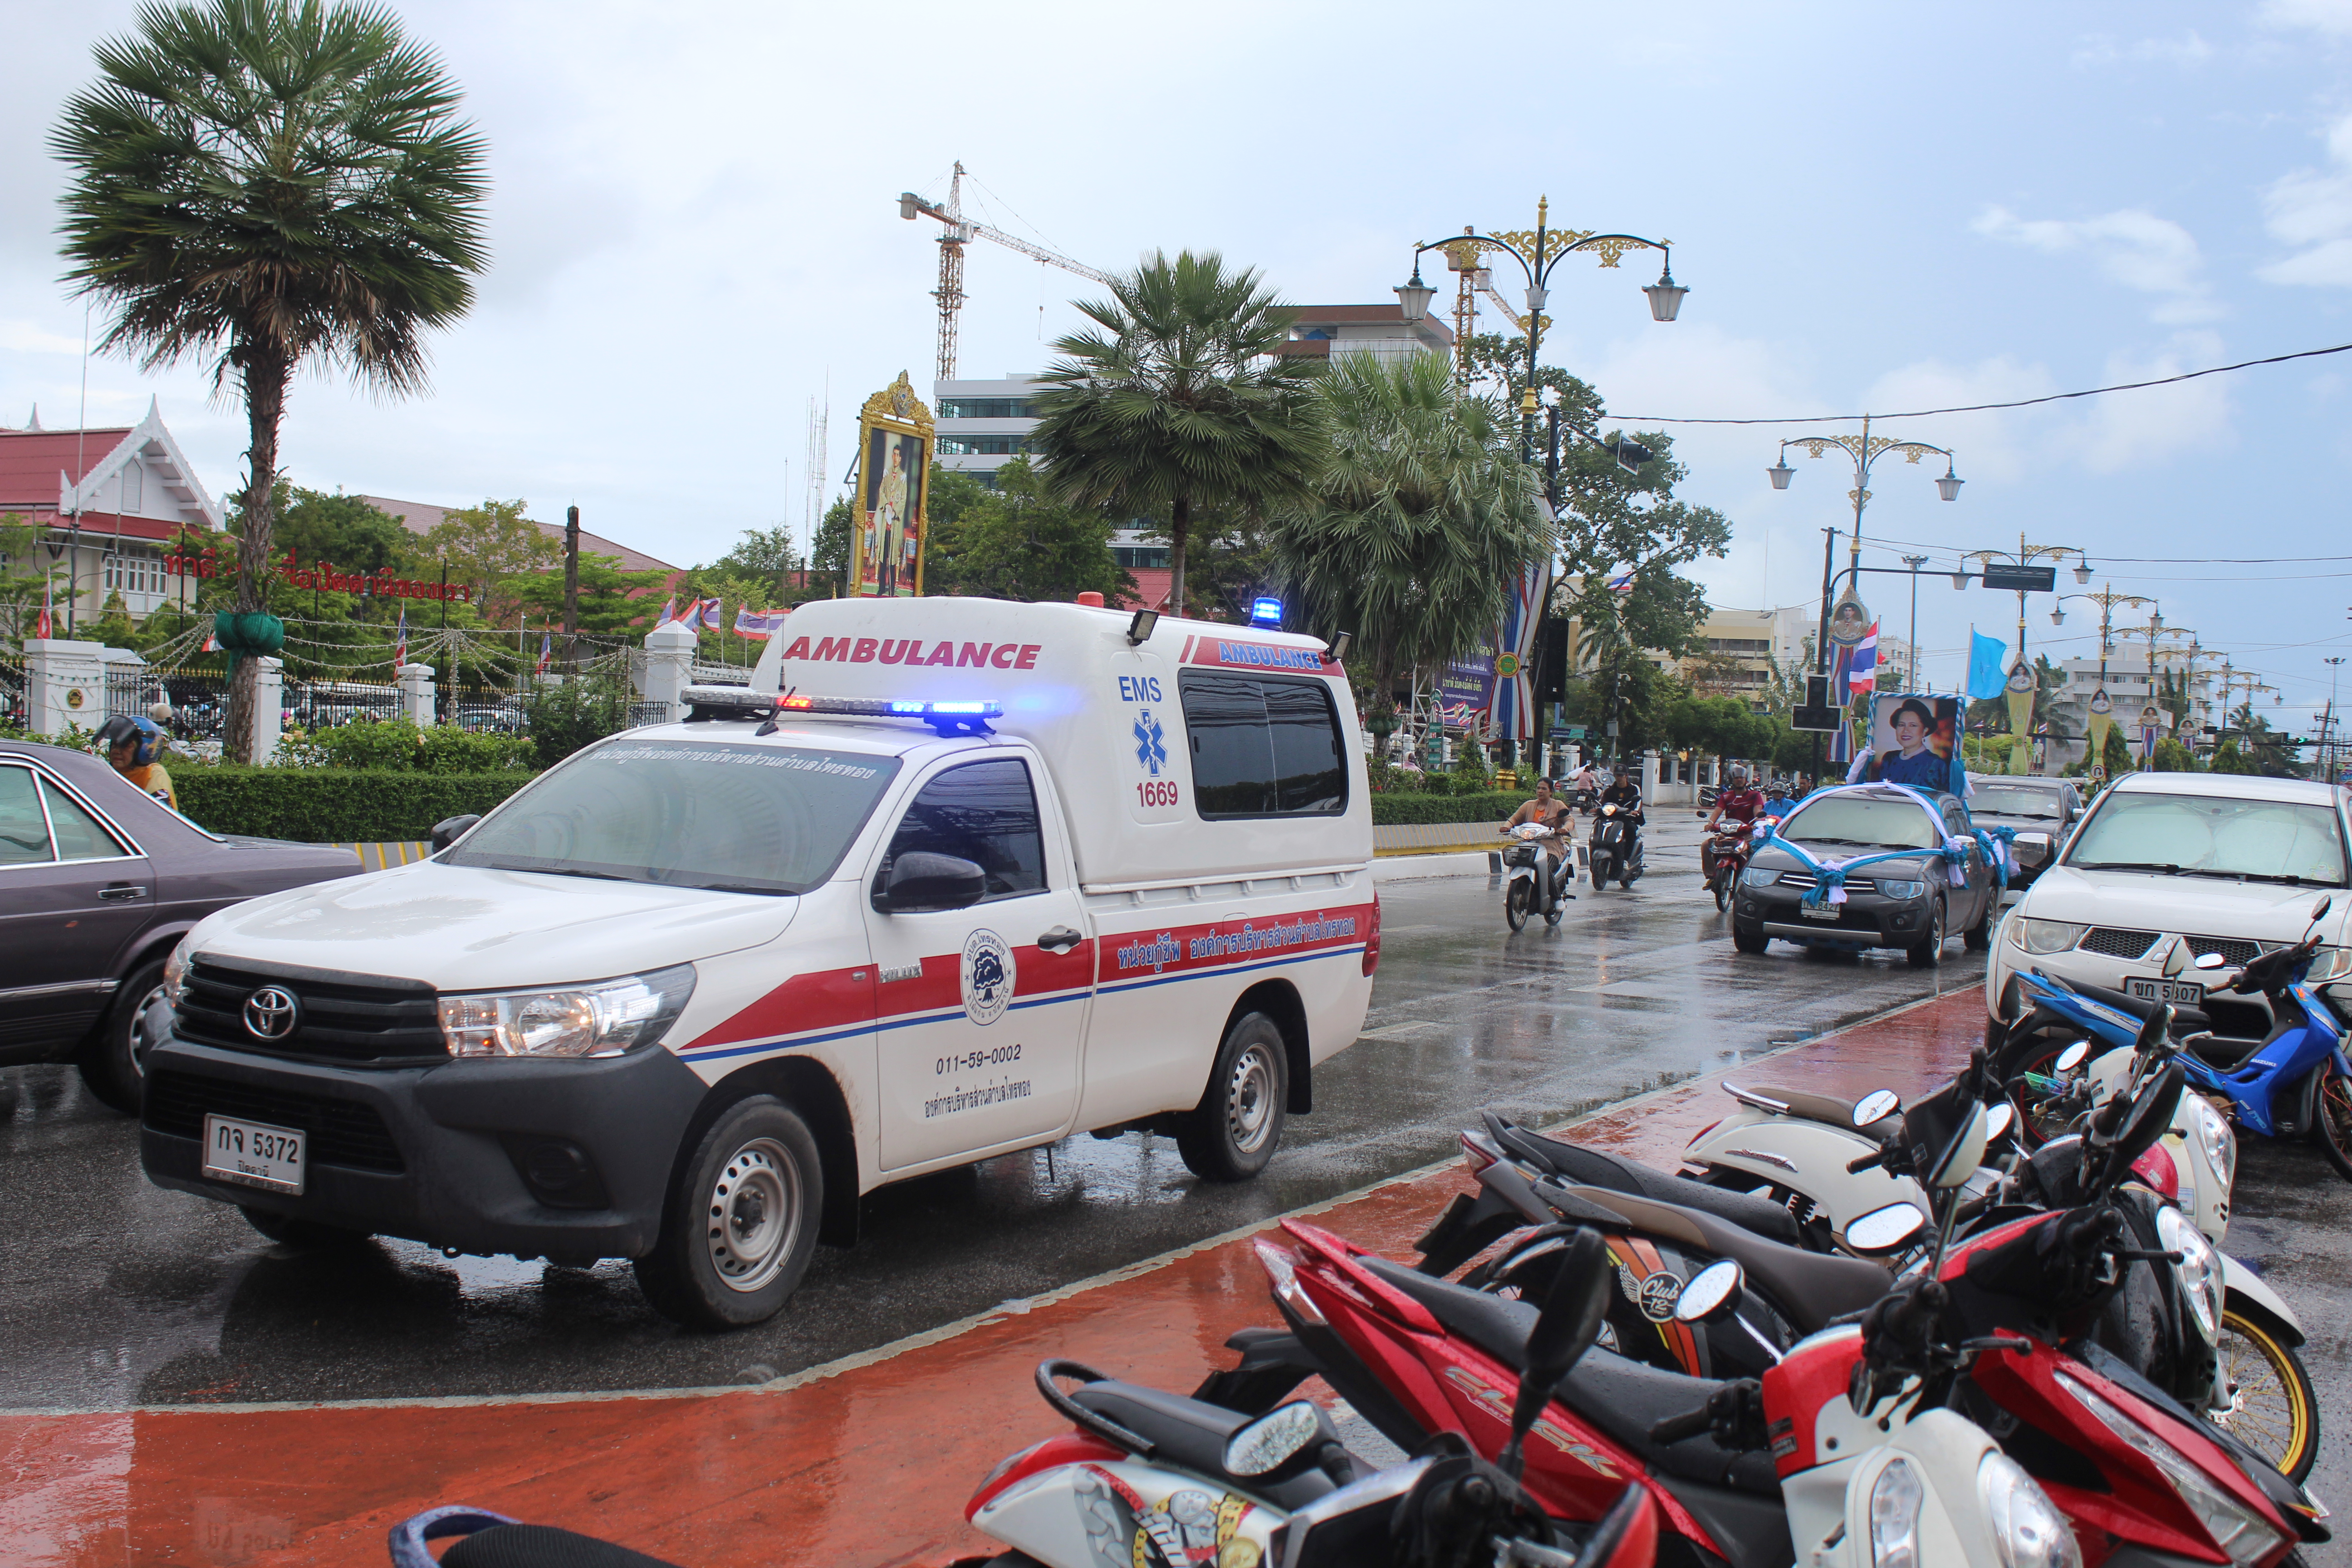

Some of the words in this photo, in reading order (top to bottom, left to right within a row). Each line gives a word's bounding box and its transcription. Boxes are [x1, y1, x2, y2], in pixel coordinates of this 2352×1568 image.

[781, 636, 1042, 670] AMBULANCE
[1218, 641, 1323, 670] AMBULANCE
[1118, 676, 1162, 702] EMS
[1137, 781, 1178, 807] 1669
[966, 932, 1006, 961] อบต.ไทรทอง
[1117, 932, 1181, 973] หน่วยกู้ชีพ
[1190, 911, 1356, 959] องค์การบริหารส่วนตำบลไทรทอง
[879, 963, 922, 984] HILUX
[2134, 982, 2155, 997] ขก
[936, 1044, 1022, 1075] 011-59-0002
[2250, 1058, 2278, 1067] SUZUKI
[924, 1075, 1031, 1118] องค์การบริหารส่วนตำบลไทรทอง
[218, 1125, 245, 1153] กจ
[253, 1132, 298, 1164] 5372
[1642, 1279, 1679, 1300] Club
[1650, 1297, 1668, 1311] 12
[1445, 1366, 1622, 1480] CLCK
